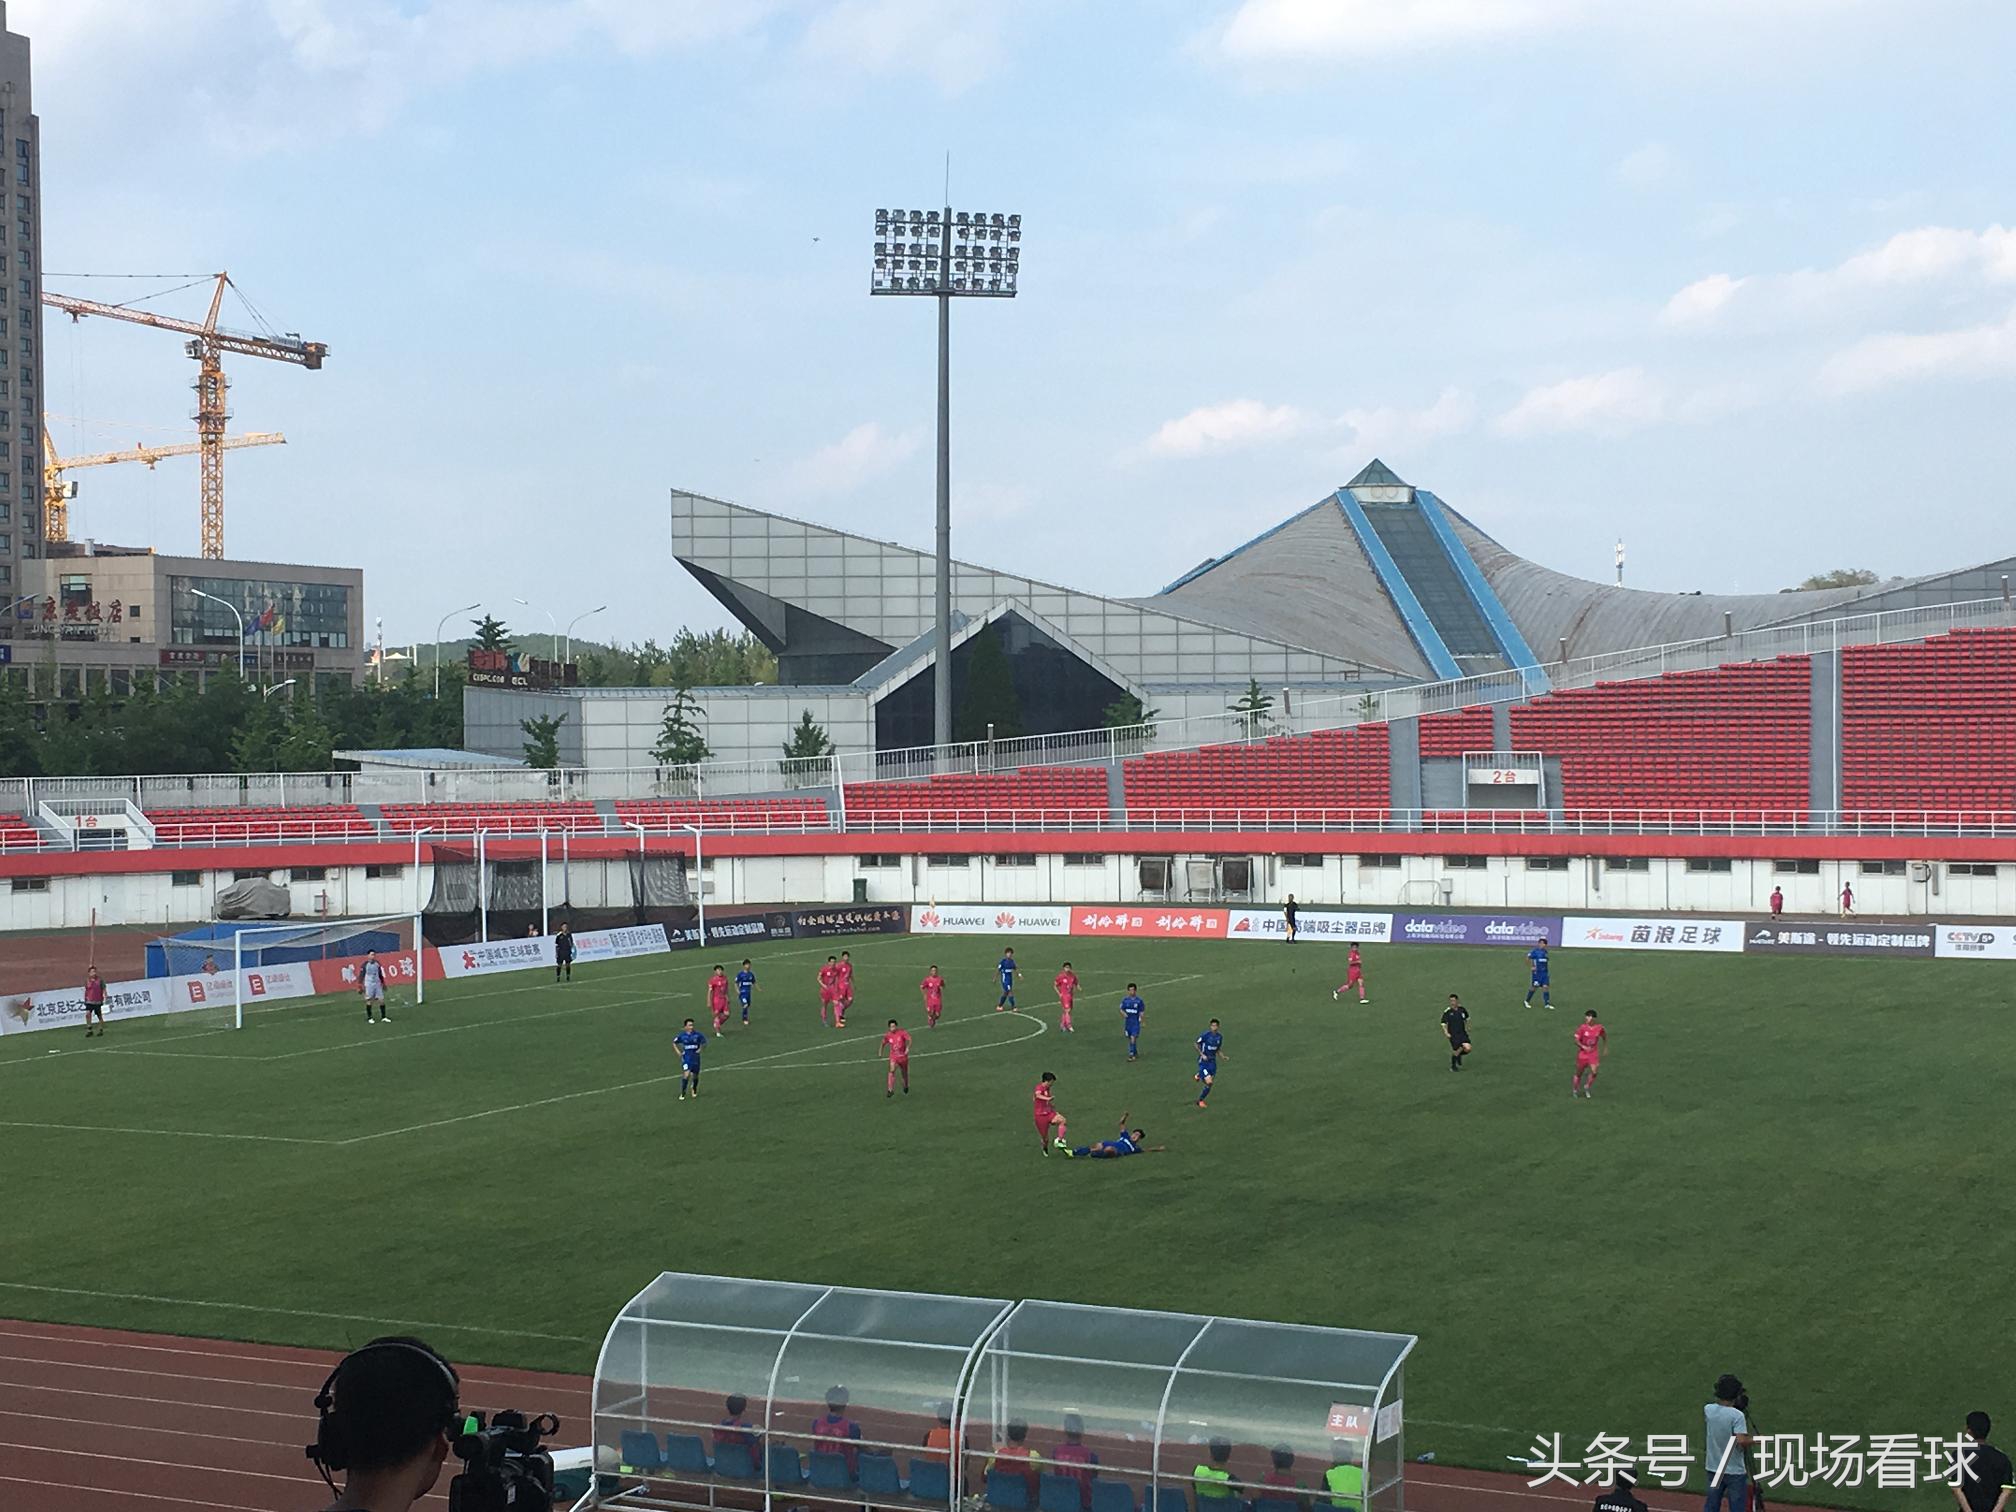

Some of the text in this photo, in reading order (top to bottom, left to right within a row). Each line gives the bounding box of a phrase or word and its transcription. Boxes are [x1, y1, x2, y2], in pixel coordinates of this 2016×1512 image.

[1492, 770, 1516, 783] 2台
[75, 815, 98, 828] 1台
[943, 917, 985, 926] HUAWEI
[1019, 918, 1061, 927] HUAWEI
[1405, 919, 1467, 933] datavideo
[1485, 920, 1549, 936] datavideo
[1630, 925, 1722, 945] 茵浪足球
[1330, 1414, 1358, 1429] 主队
